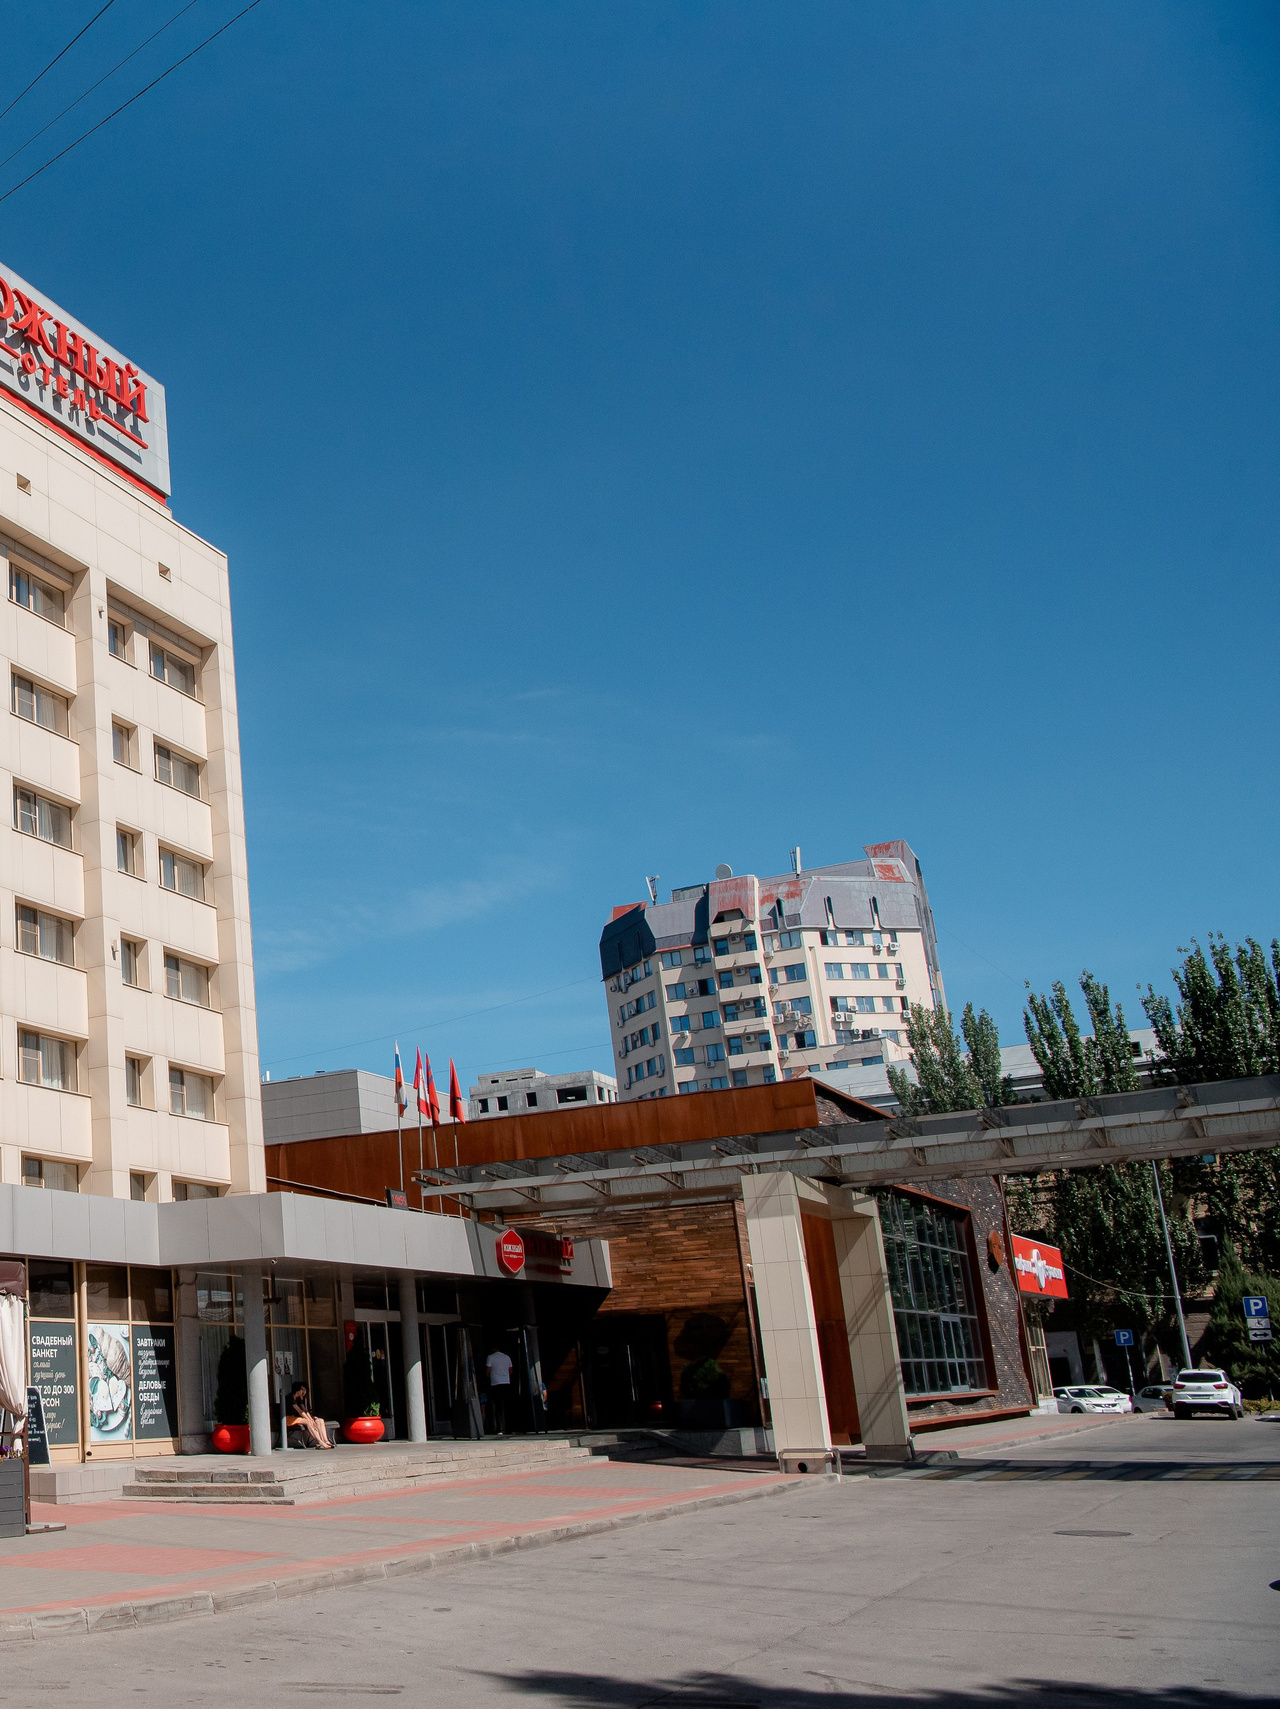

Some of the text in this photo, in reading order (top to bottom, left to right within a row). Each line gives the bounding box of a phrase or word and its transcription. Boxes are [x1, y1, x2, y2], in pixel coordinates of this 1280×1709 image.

[21, 352, 102, 421] ОТЕЛЬ
[1250, 1299, 1263, 1315] P
[31, 1335, 73, 1347] СВАДЕБНЫЙ
[1120, 1332, 1130, 1341] P
[136, 1337, 166, 1347] ЗАВТРАКИ
[32, 1348, 58, 1358] БАНКЕТ
[43, 1385, 51, 1395] 20
[52, 1385, 62, 1396] ДО
[63, 1385, 75, 1394] 300
[138, 1381, 166, 1391] ДЕЛОВЫЕ
[41, 1397, 60, 1407] РСОН
[138, 1392, 160, 1403] ОБЕДЫ
